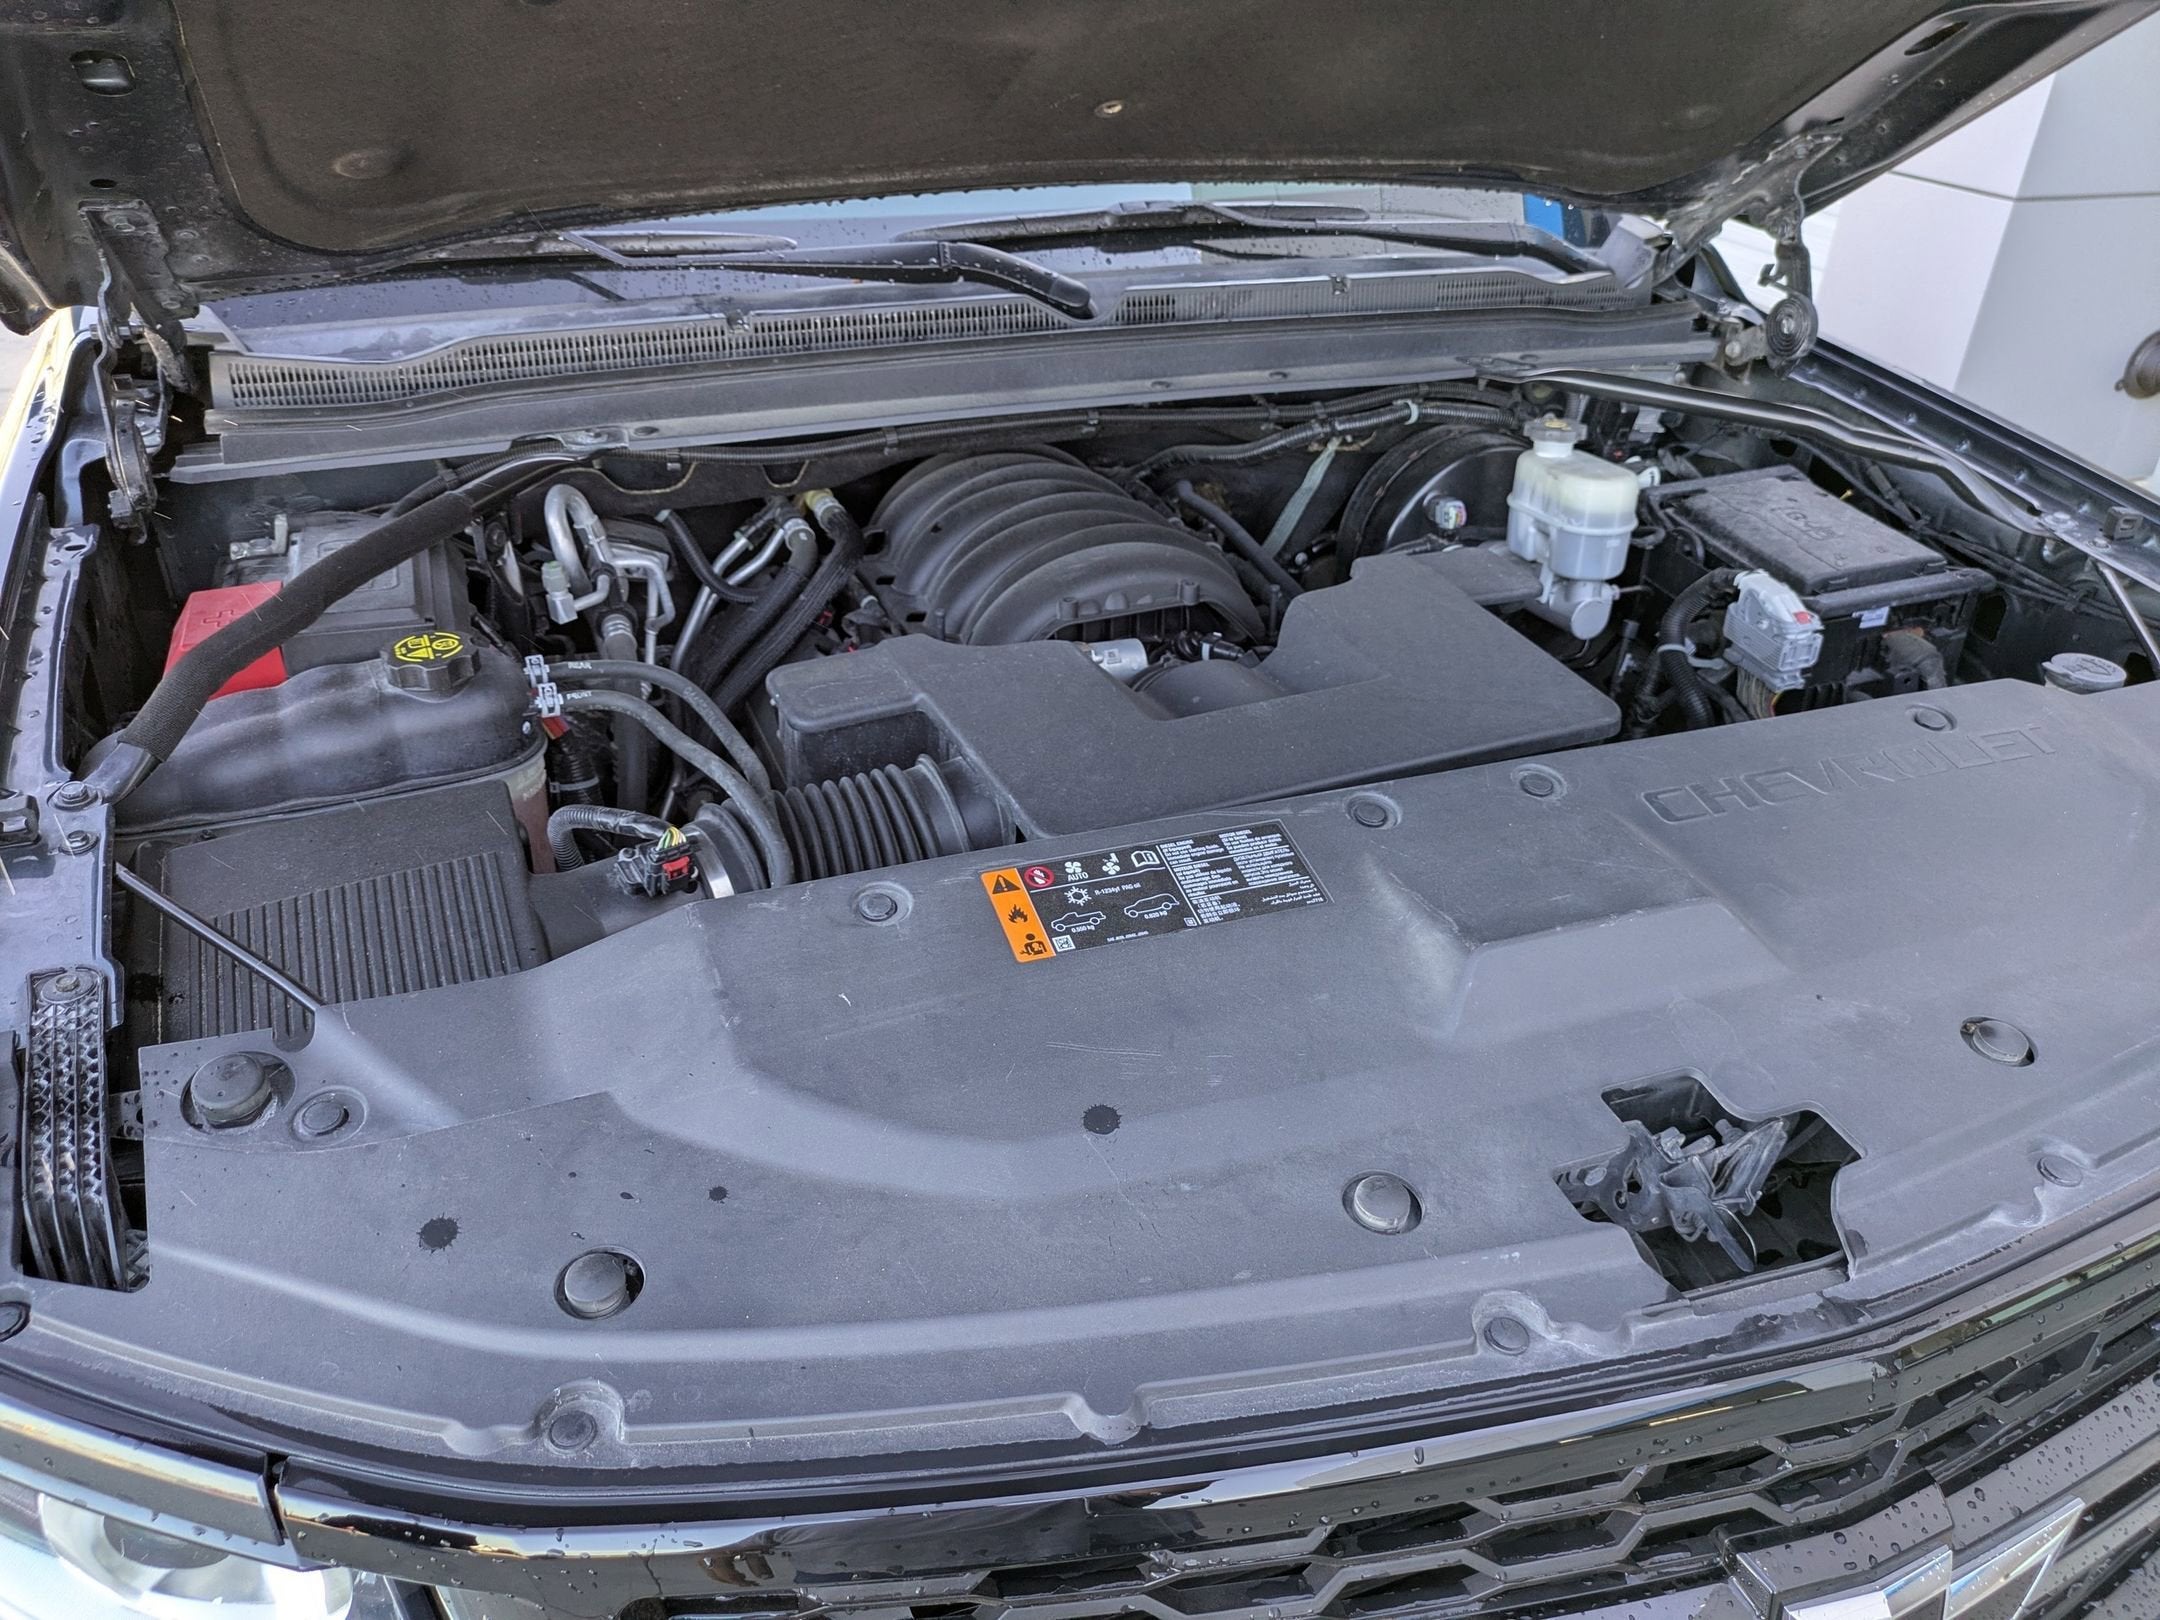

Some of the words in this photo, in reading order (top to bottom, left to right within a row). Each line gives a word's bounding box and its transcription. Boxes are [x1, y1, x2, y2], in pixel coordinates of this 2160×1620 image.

[568, 661, 592, 670] REAR
[566, 690, 592, 700] FRONT
[1641, 726, 2056, 825] CHEVROLET
[1068, 871, 1089, 882] AUTO
